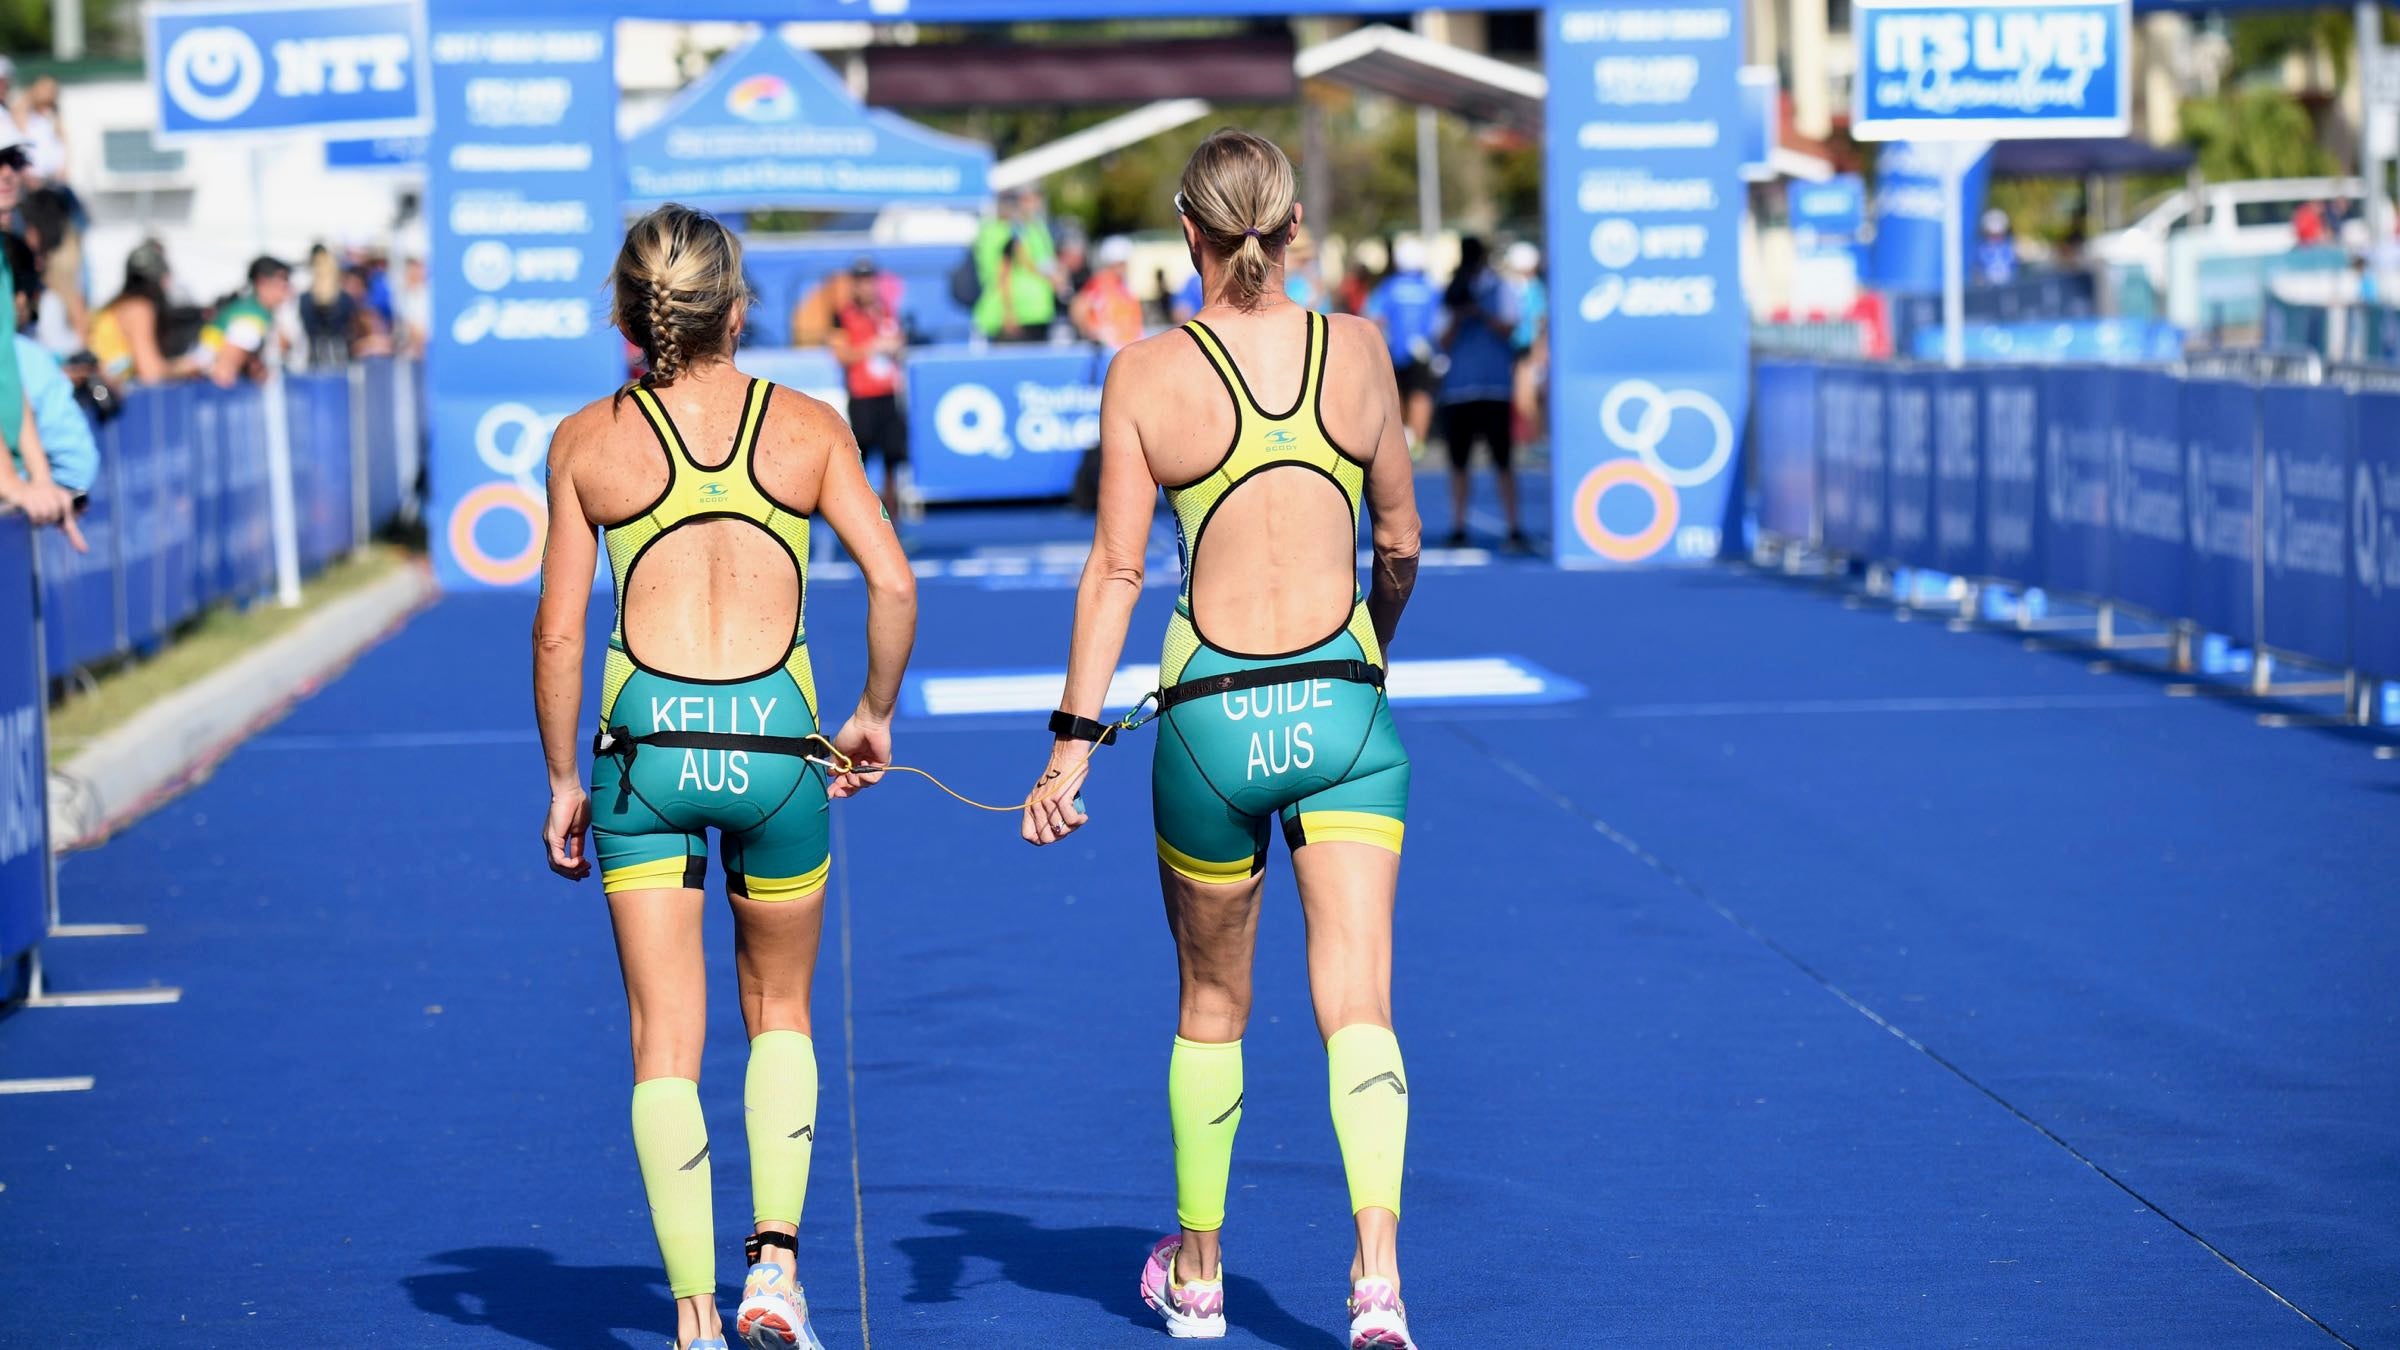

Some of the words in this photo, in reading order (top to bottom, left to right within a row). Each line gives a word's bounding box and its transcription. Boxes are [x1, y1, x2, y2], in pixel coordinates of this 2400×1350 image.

[272, 34, 409, 97] NTT
[651, 696, 777, 736] KELLY
[1222, 679, 1333, 720] GUIDE
[678, 748, 749, 794] AUS
[1247, 721, 1314, 781] AUS
